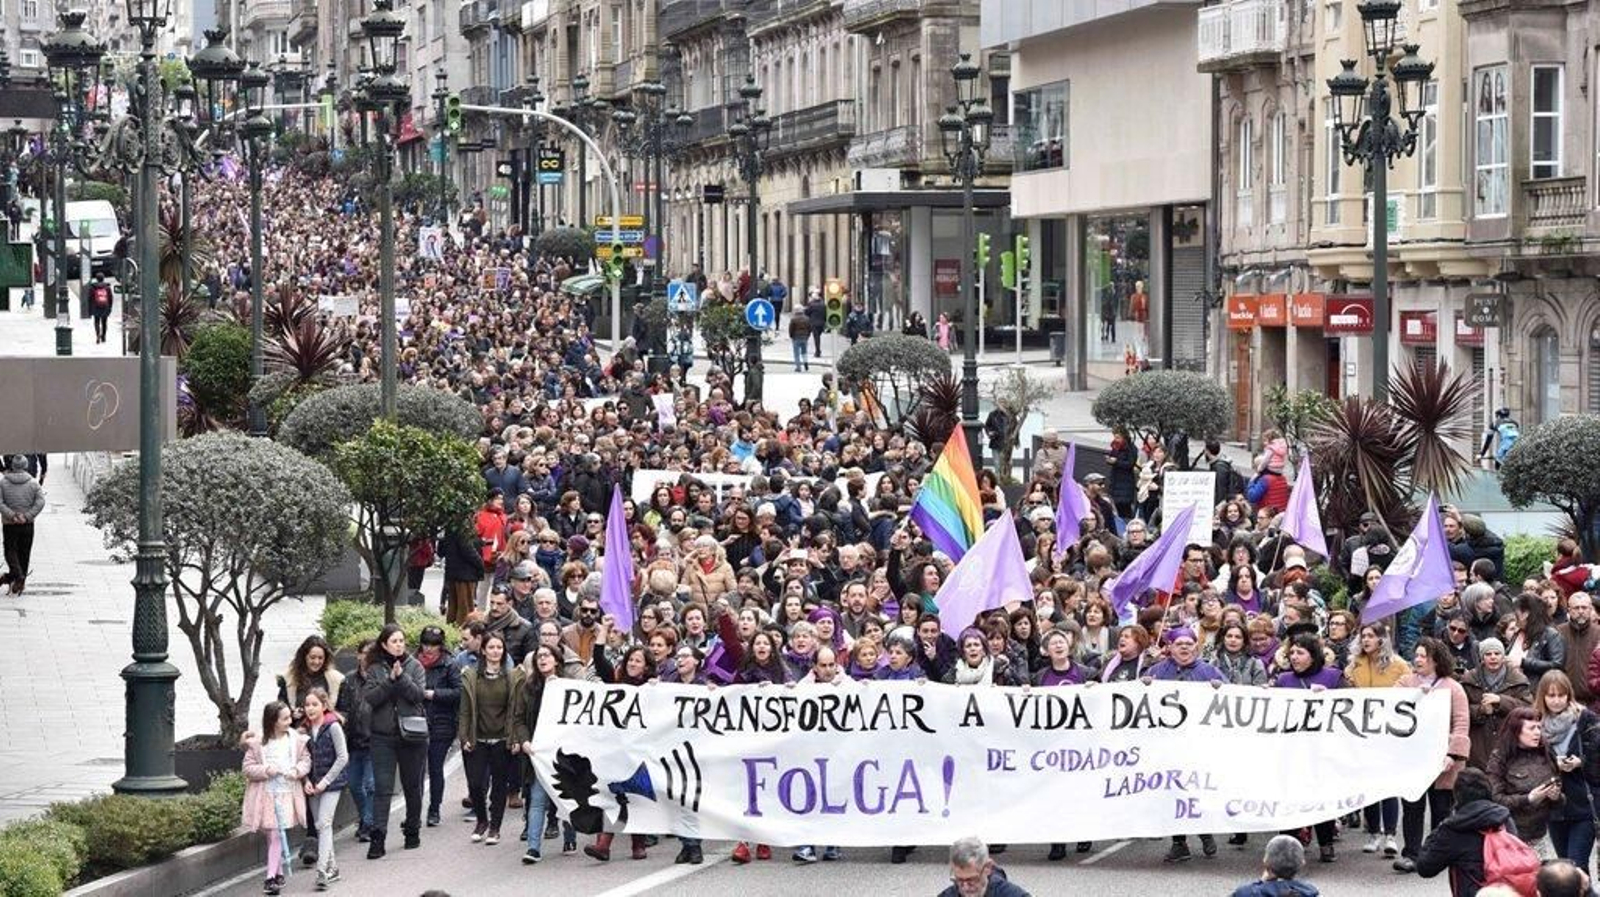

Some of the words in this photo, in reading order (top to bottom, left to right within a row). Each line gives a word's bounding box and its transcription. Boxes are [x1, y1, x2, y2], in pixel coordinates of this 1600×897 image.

[1471, 314, 1500, 322] ROMA
[556, 689, 647, 729] PARA
[674, 693, 936, 735] TRANSFORMAR
[958, 692, 985, 728] A
[1004, 692, 1092, 730] VIDA
[1110, 690, 1188, 730] DAS
[1200, 693, 1418, 738] MULLERES
[987, 748, 1016, 771] DE
[1030, 747, 1140, 772] COIDADOS
[1104, 769, 1218, 798] LABORAL
[1175, 798, 1202, 819] DE
